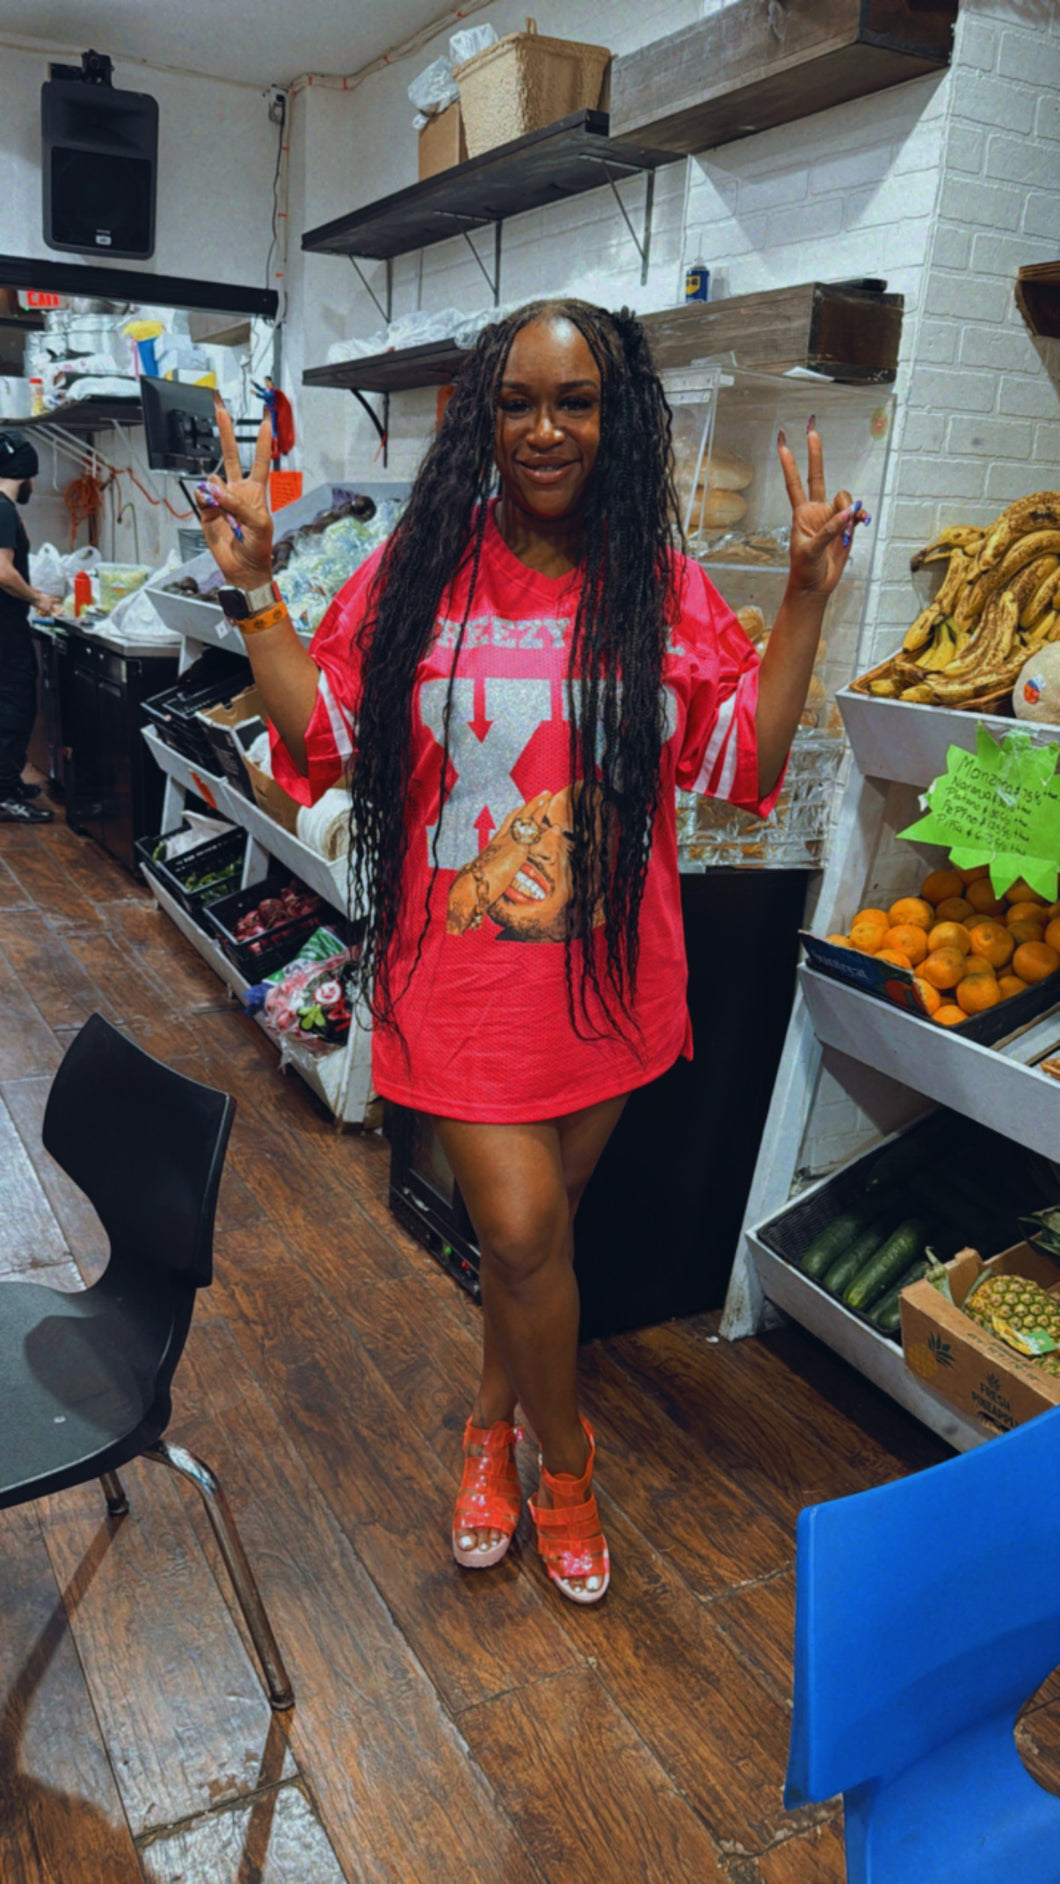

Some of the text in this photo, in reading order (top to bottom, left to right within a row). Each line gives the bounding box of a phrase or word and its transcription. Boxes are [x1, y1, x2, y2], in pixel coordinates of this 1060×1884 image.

[431, 616, 571, 652] REEZY
[971, 1391, 1019, 1428] PINEAPPL
[980, 1382, 1011, 1411] FRESH
